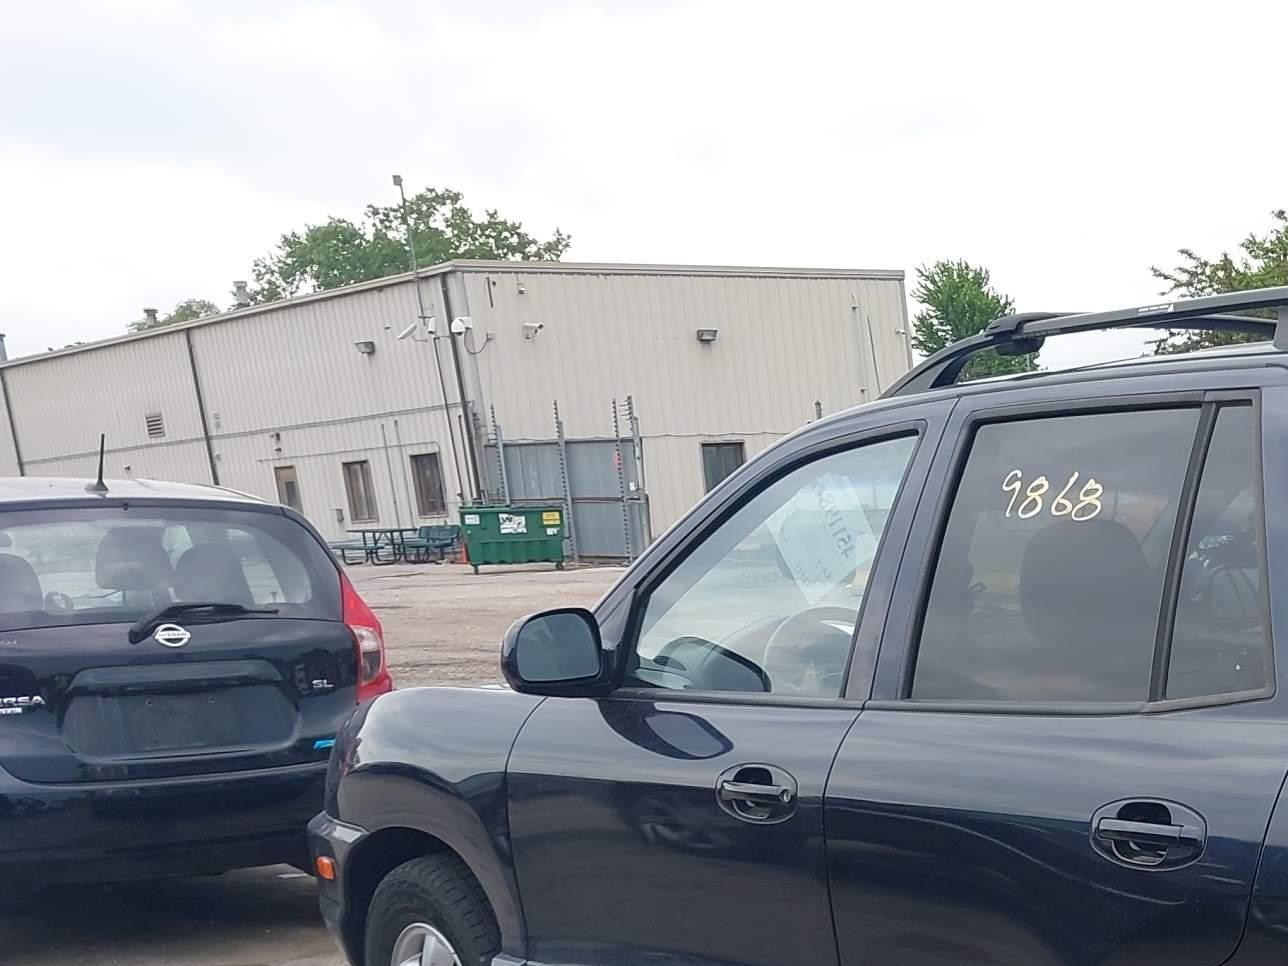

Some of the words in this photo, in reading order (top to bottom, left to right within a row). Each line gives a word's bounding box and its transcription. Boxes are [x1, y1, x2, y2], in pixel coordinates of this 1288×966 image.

[1002, 469, 1104, 521] 9868
[311, 679, 335, 688] SL
[0, 695, 46, 707] RSA
